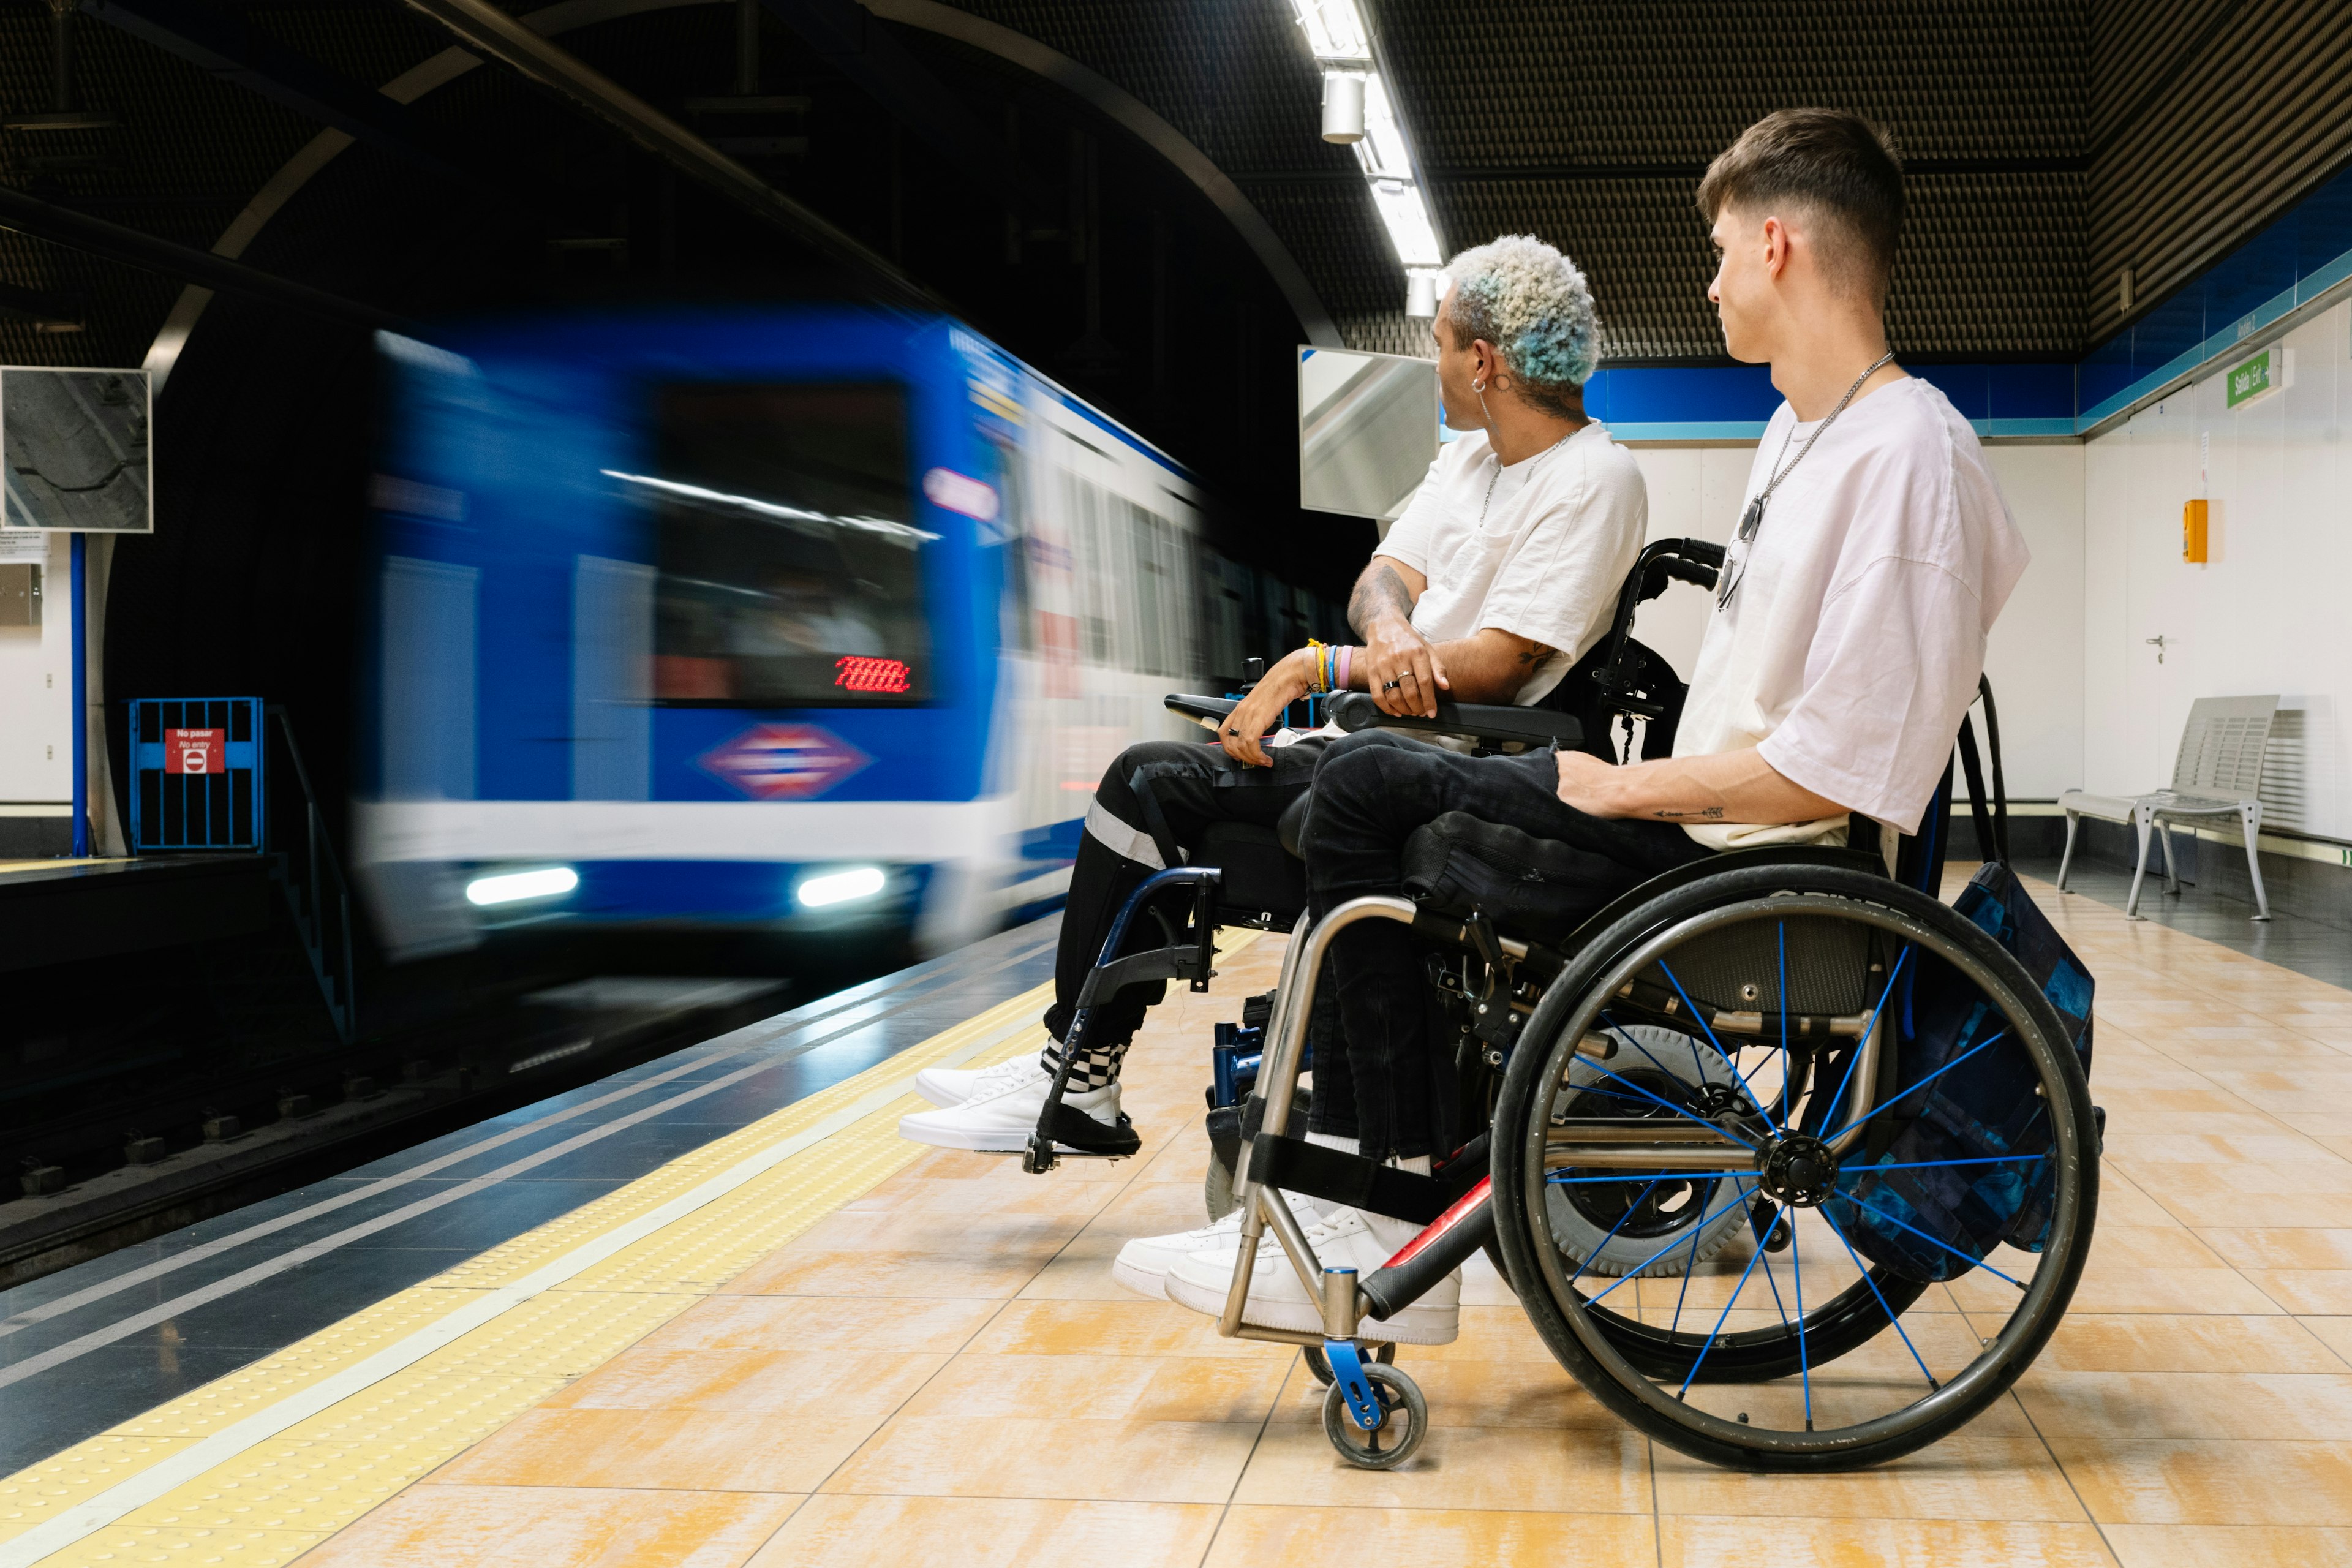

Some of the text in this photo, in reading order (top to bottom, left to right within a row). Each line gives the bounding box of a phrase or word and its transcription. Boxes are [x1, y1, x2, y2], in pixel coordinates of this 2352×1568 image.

[2235, 364, 2261, 396] Salida Exit
[190, 730, 213, 739] pasar
[192, 741, 211, 750] entry
